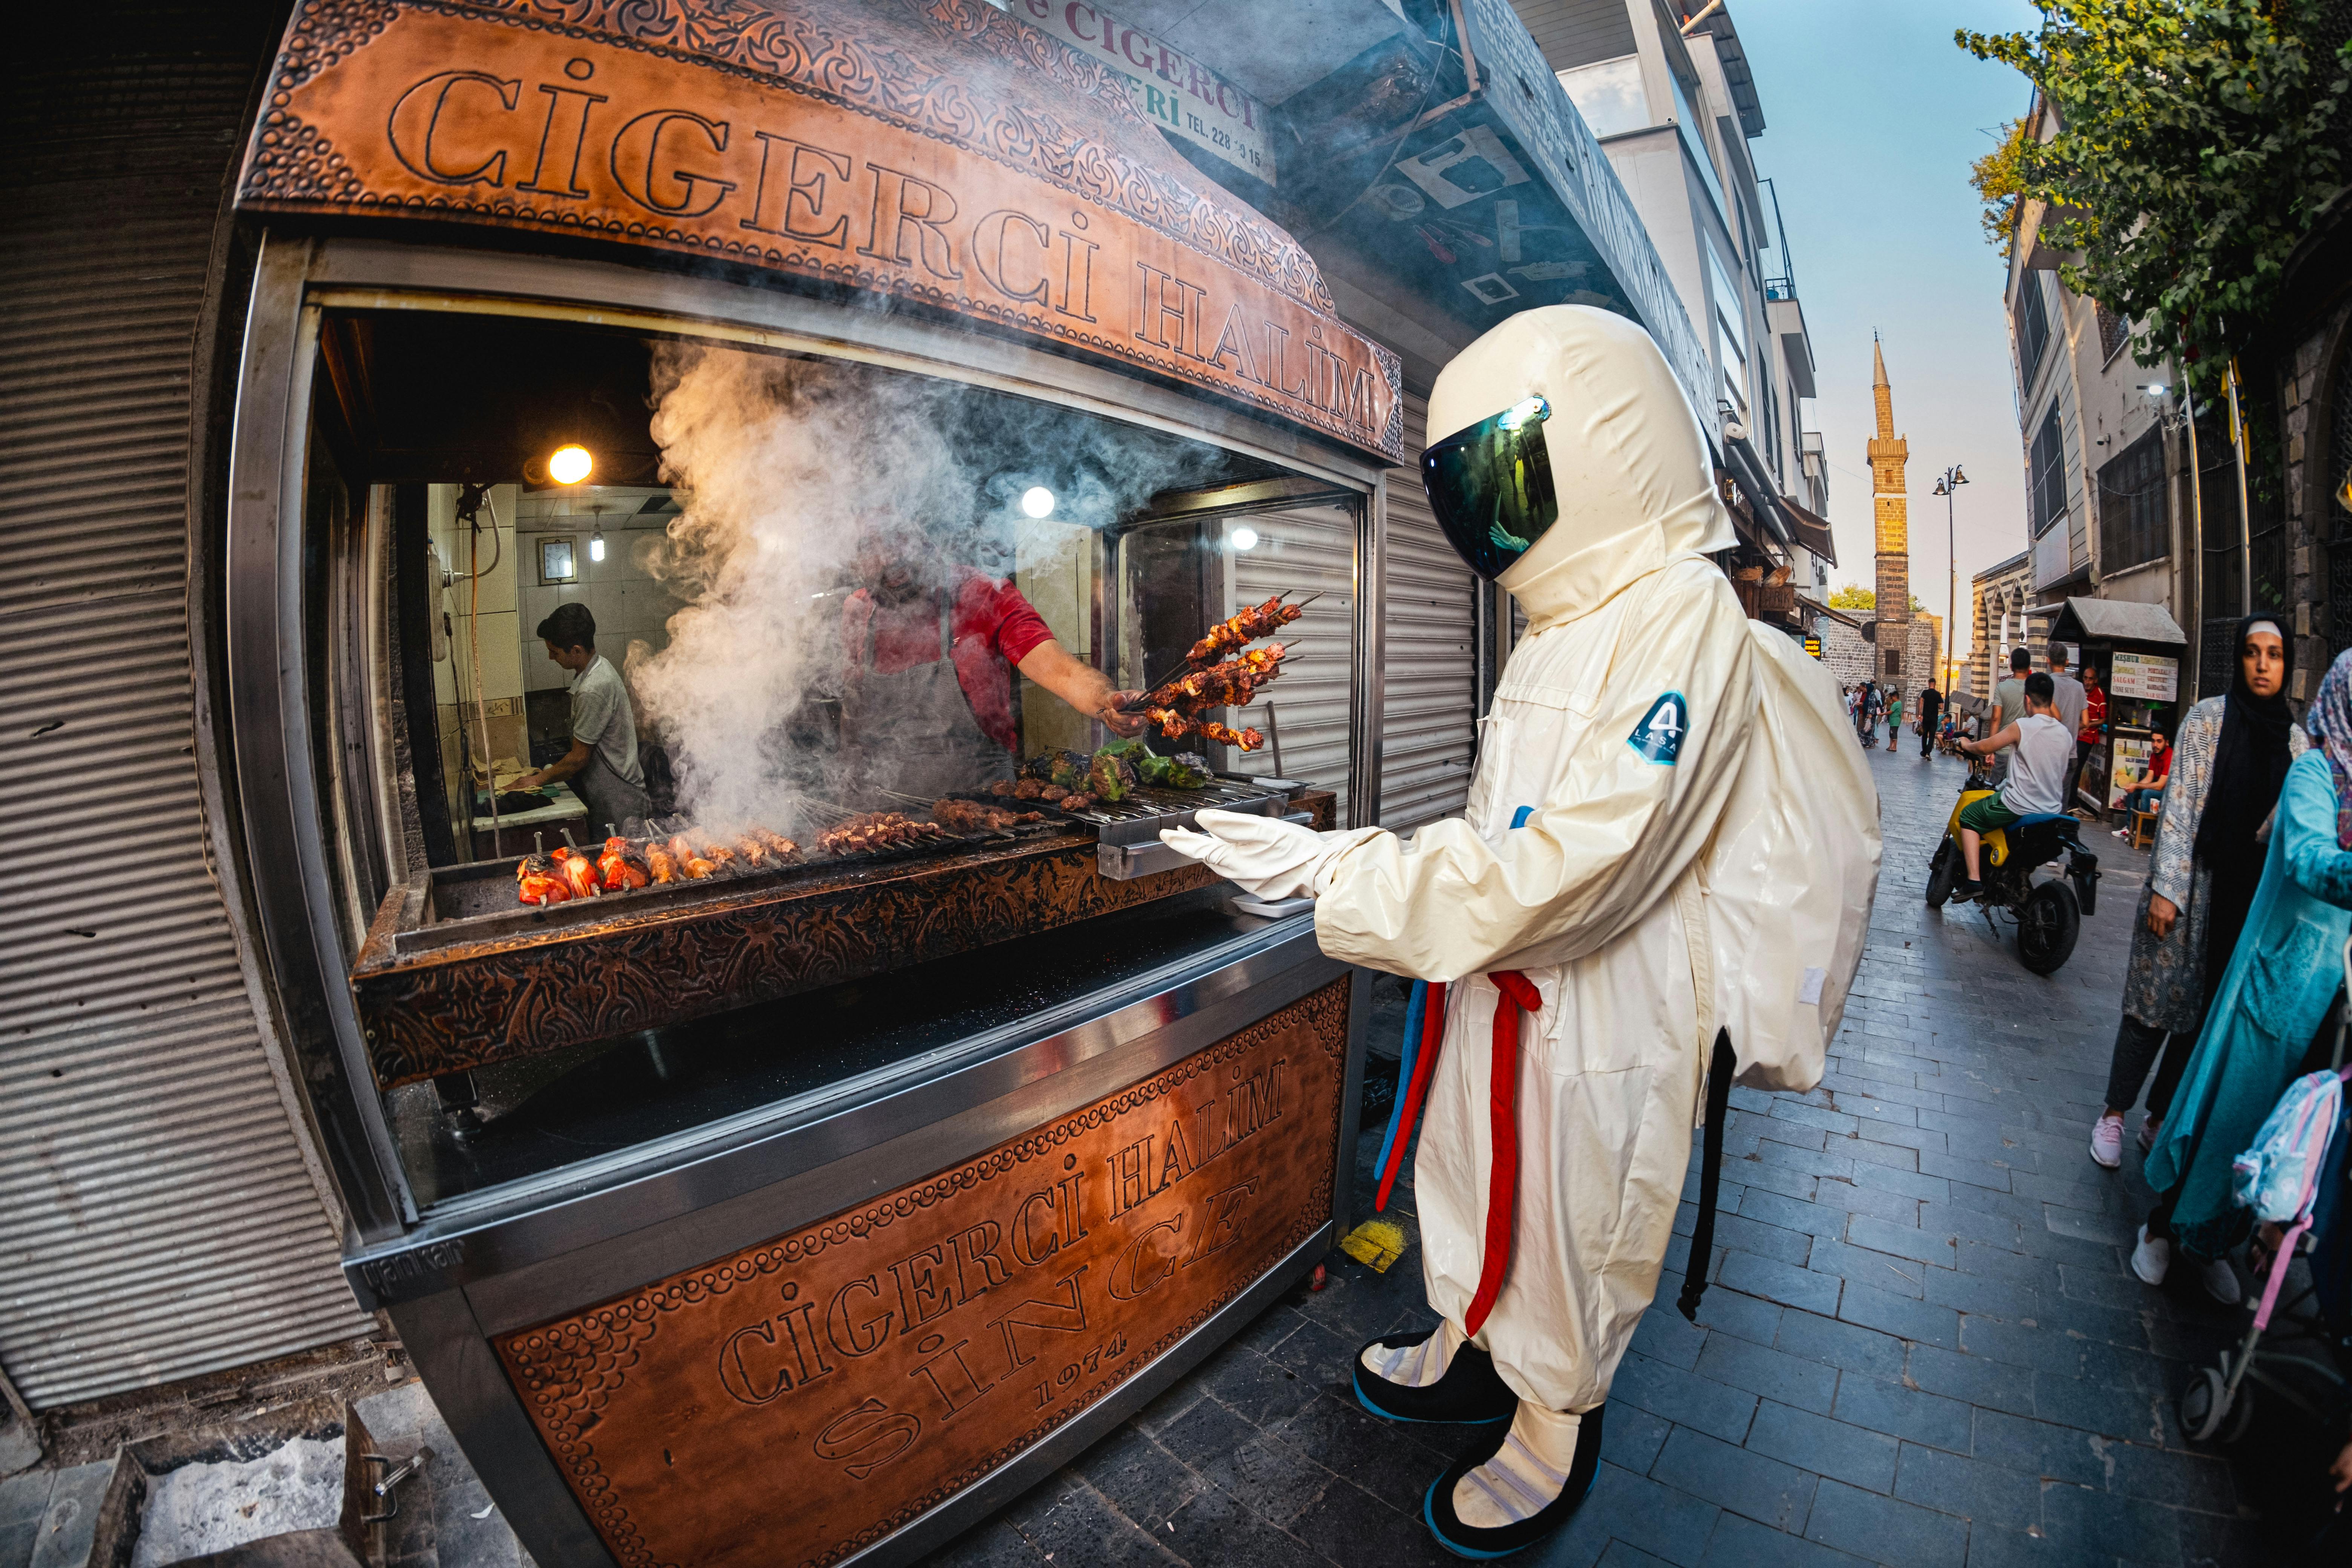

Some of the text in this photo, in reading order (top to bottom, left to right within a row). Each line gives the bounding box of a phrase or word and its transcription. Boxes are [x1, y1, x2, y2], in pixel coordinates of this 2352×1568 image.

[1187, 112, 1208, 139] TEL.
[1212, 126, 1231, 150] 228
[388, 57, 1375, 432] CİGERCİ HALİM
[2115, 653, 2139, 663] MEŞHUR
[718, 1058, 1286, 1406] CİGERCİ HALİM
[813, 1175, 1260, 1479] SİNCE
[1034, 1331, 1127, 1410] 1974
